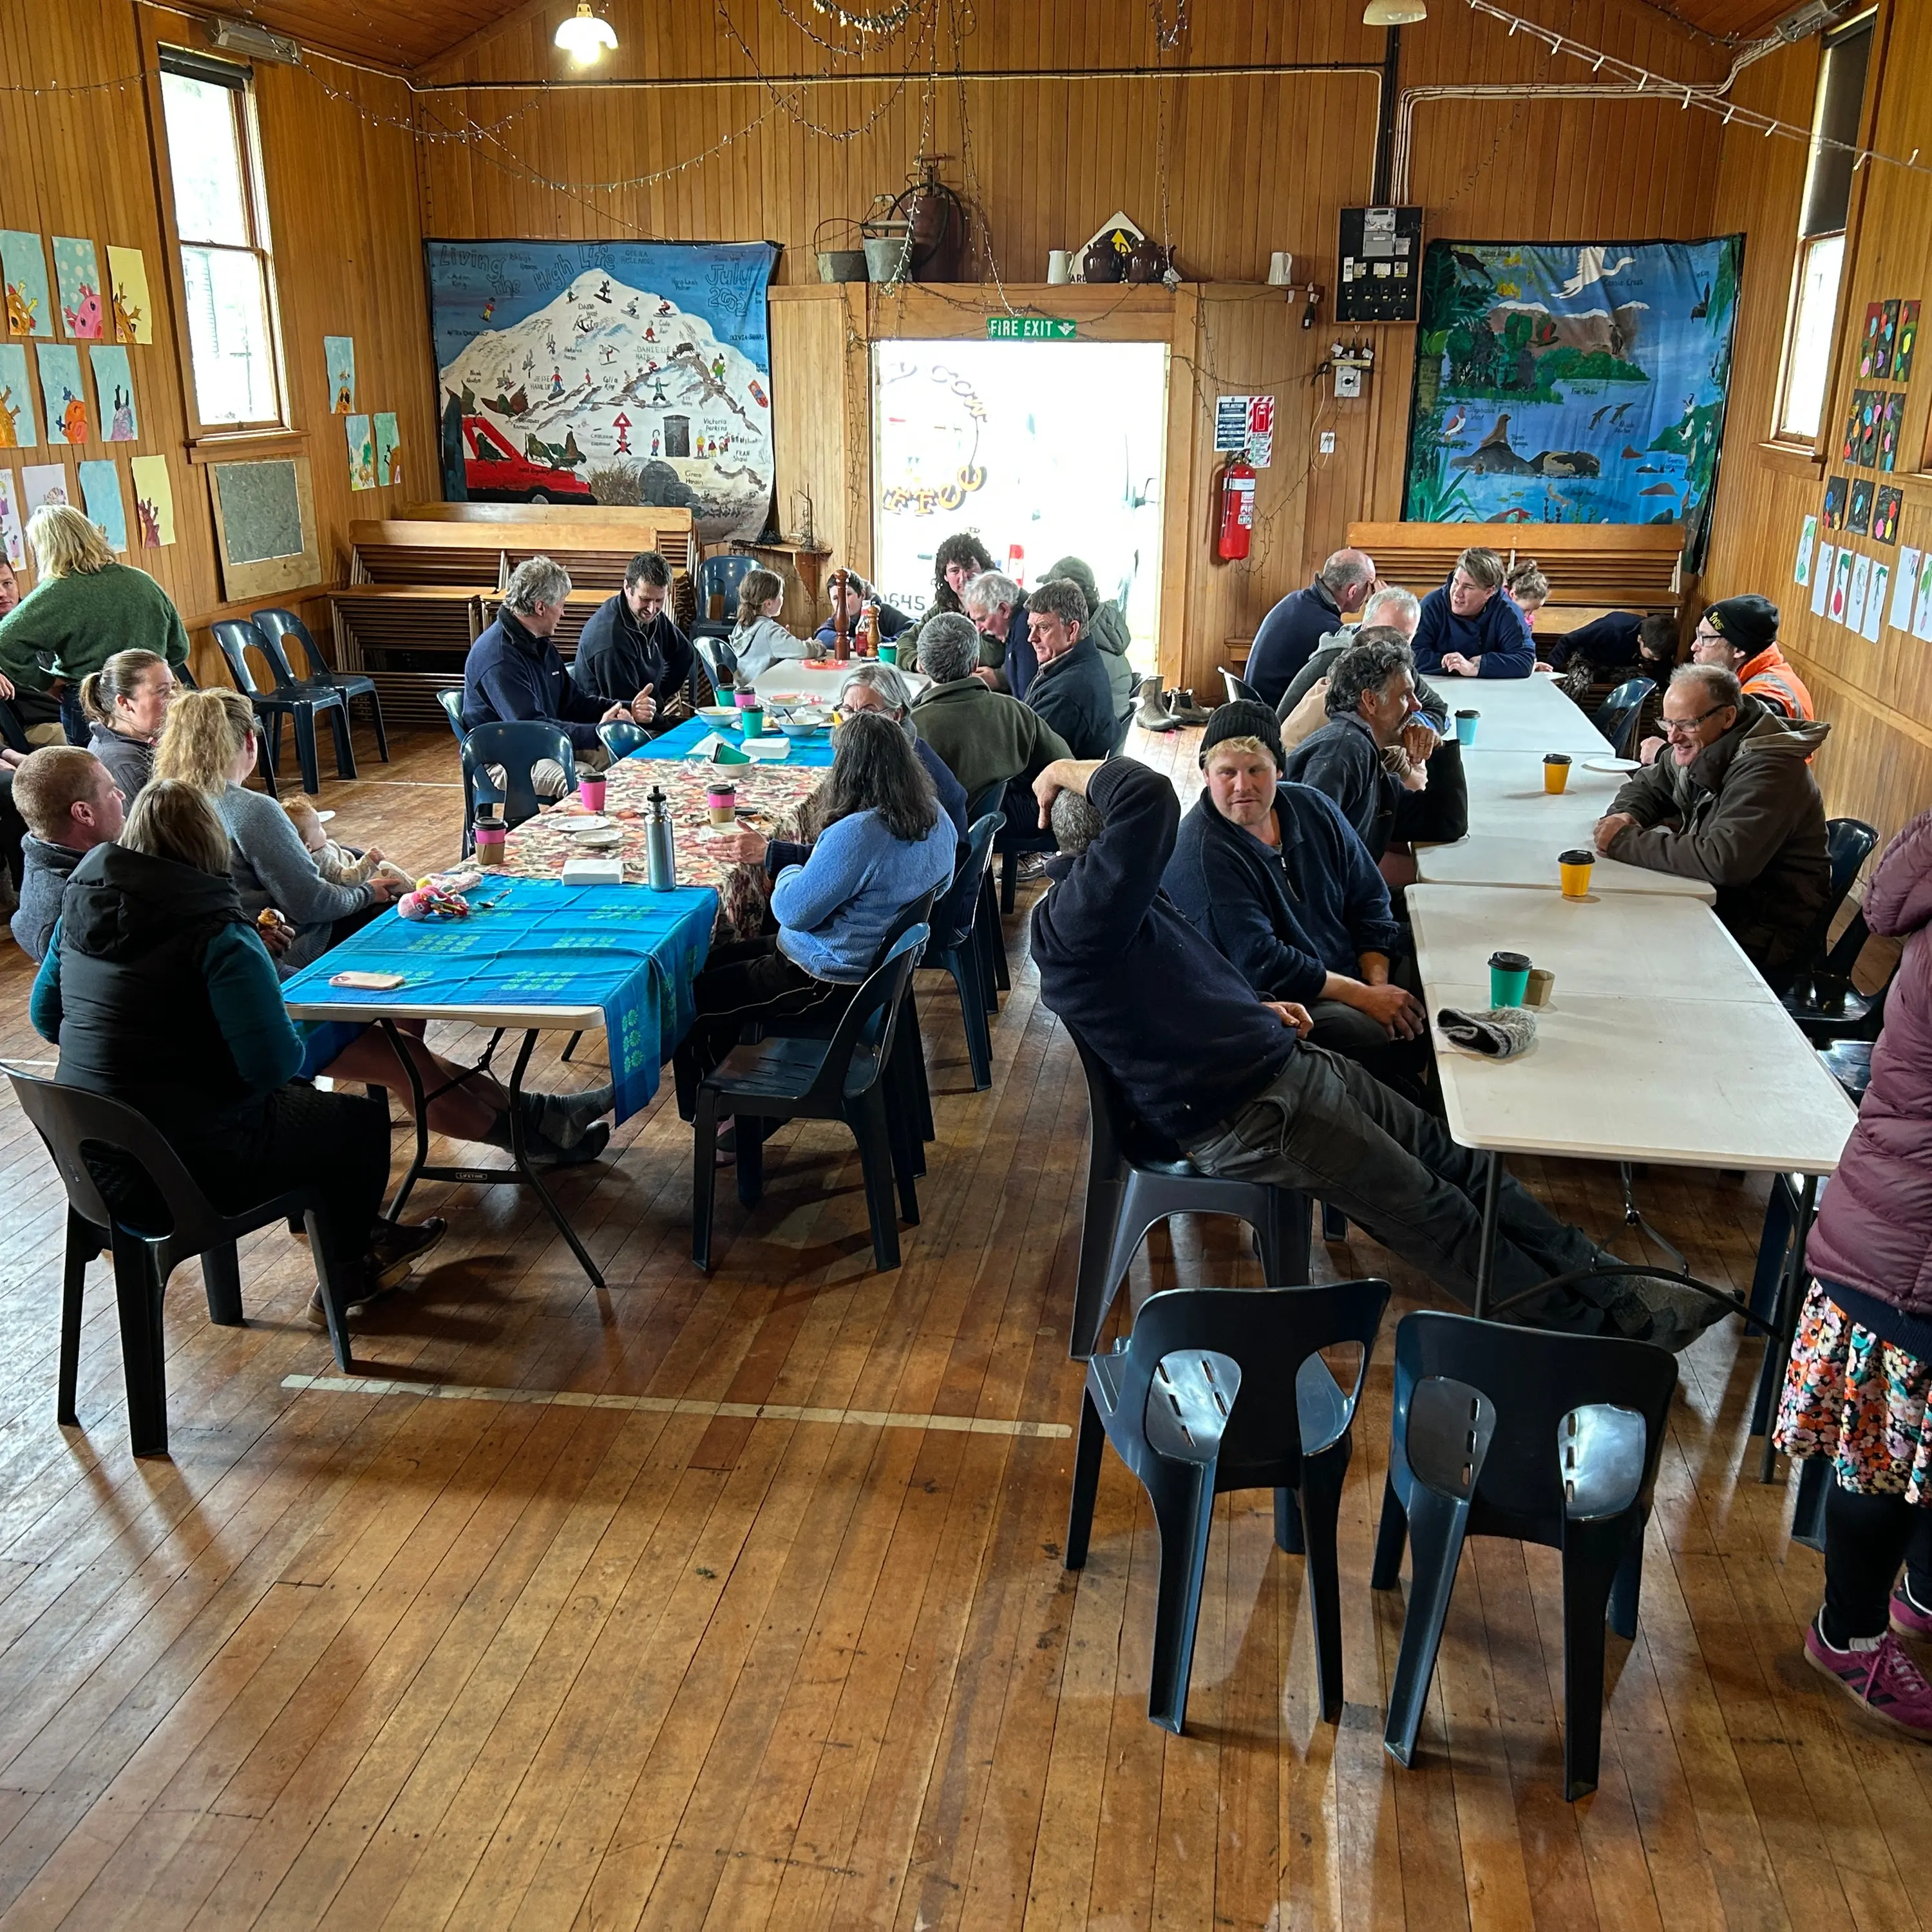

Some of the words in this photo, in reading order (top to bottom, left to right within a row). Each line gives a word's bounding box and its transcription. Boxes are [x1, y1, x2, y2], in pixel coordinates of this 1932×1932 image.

[440, 245, 506, 283] Living
[533, 254, 574, 291] High
[577, 244, 615, 270] Life
[705, 263, 753, 298] July
[708, 287, 747, 317] 2002
[990, 320, 1018, 336] FIRE
[1024, 321, 1053, 336] EXIT
